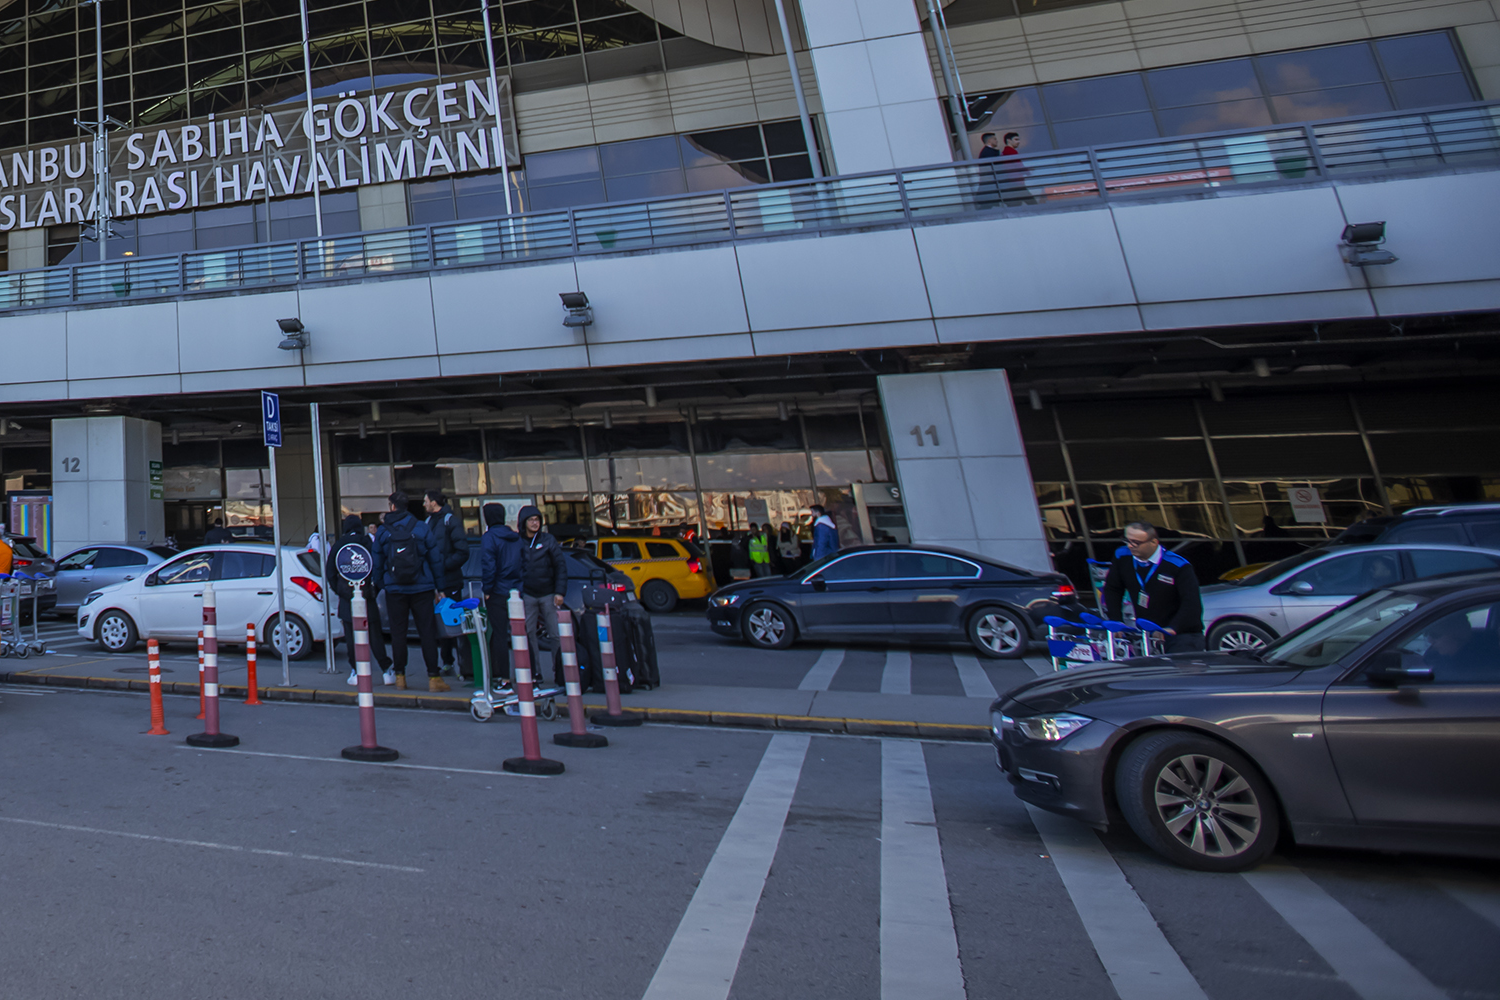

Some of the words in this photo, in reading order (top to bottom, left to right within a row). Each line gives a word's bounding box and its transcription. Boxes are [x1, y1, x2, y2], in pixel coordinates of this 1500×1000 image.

[127, 112, 285, 170] SABİHA
[302, 76, 498, 143] GÖKÇEN
[215, 126, 503, 204] HAVALİMANI
[266, 396, 275, 418] D
[909, 424, 940, 447] 11
[61, 457, 81, 473] 12
